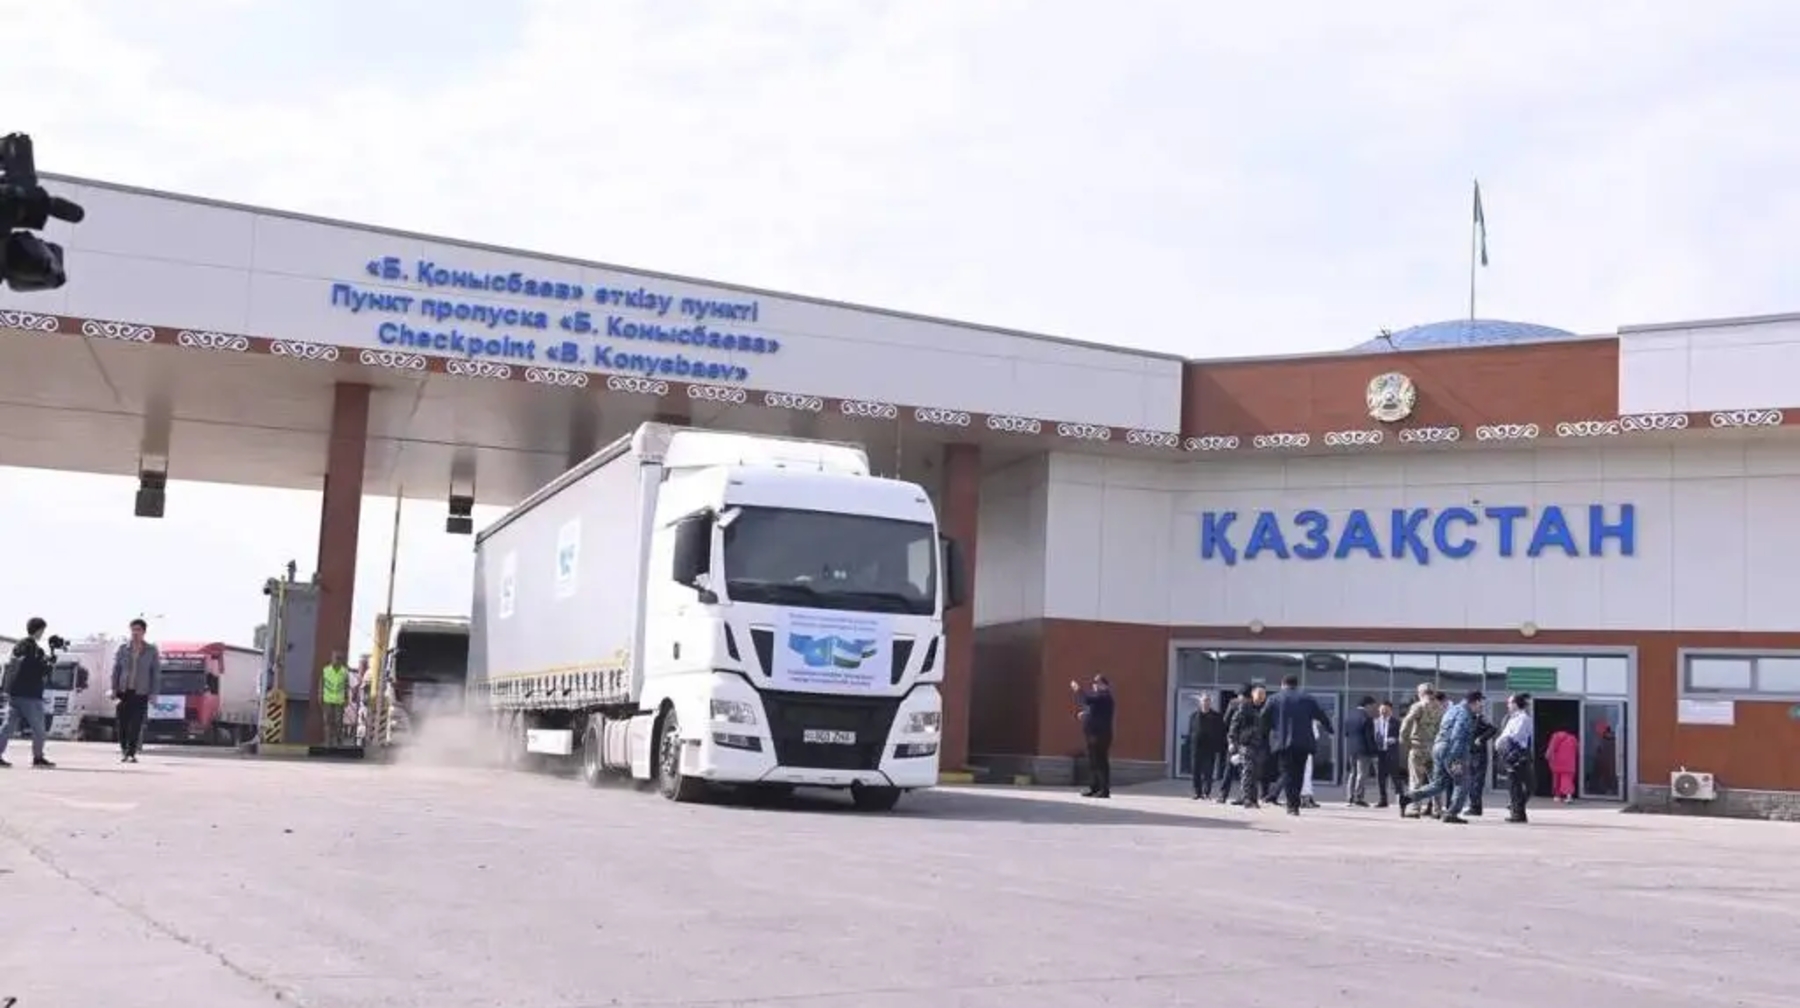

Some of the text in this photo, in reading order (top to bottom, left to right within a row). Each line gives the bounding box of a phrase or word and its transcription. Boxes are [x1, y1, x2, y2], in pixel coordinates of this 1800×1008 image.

[331, 283, 780, 353] Пункт пропуска «Б. Конысбаева»
[366, 256, 408, 281] «Б.
[418, 260, 584, 300] Қонысбаев»
[681, 297, 759, 322] пункті
[378, 322, 748, 380] Checkpoint «B. Konysbaev»
[1201, 503, 1635, 566] ҚАЗАҚСТАН
